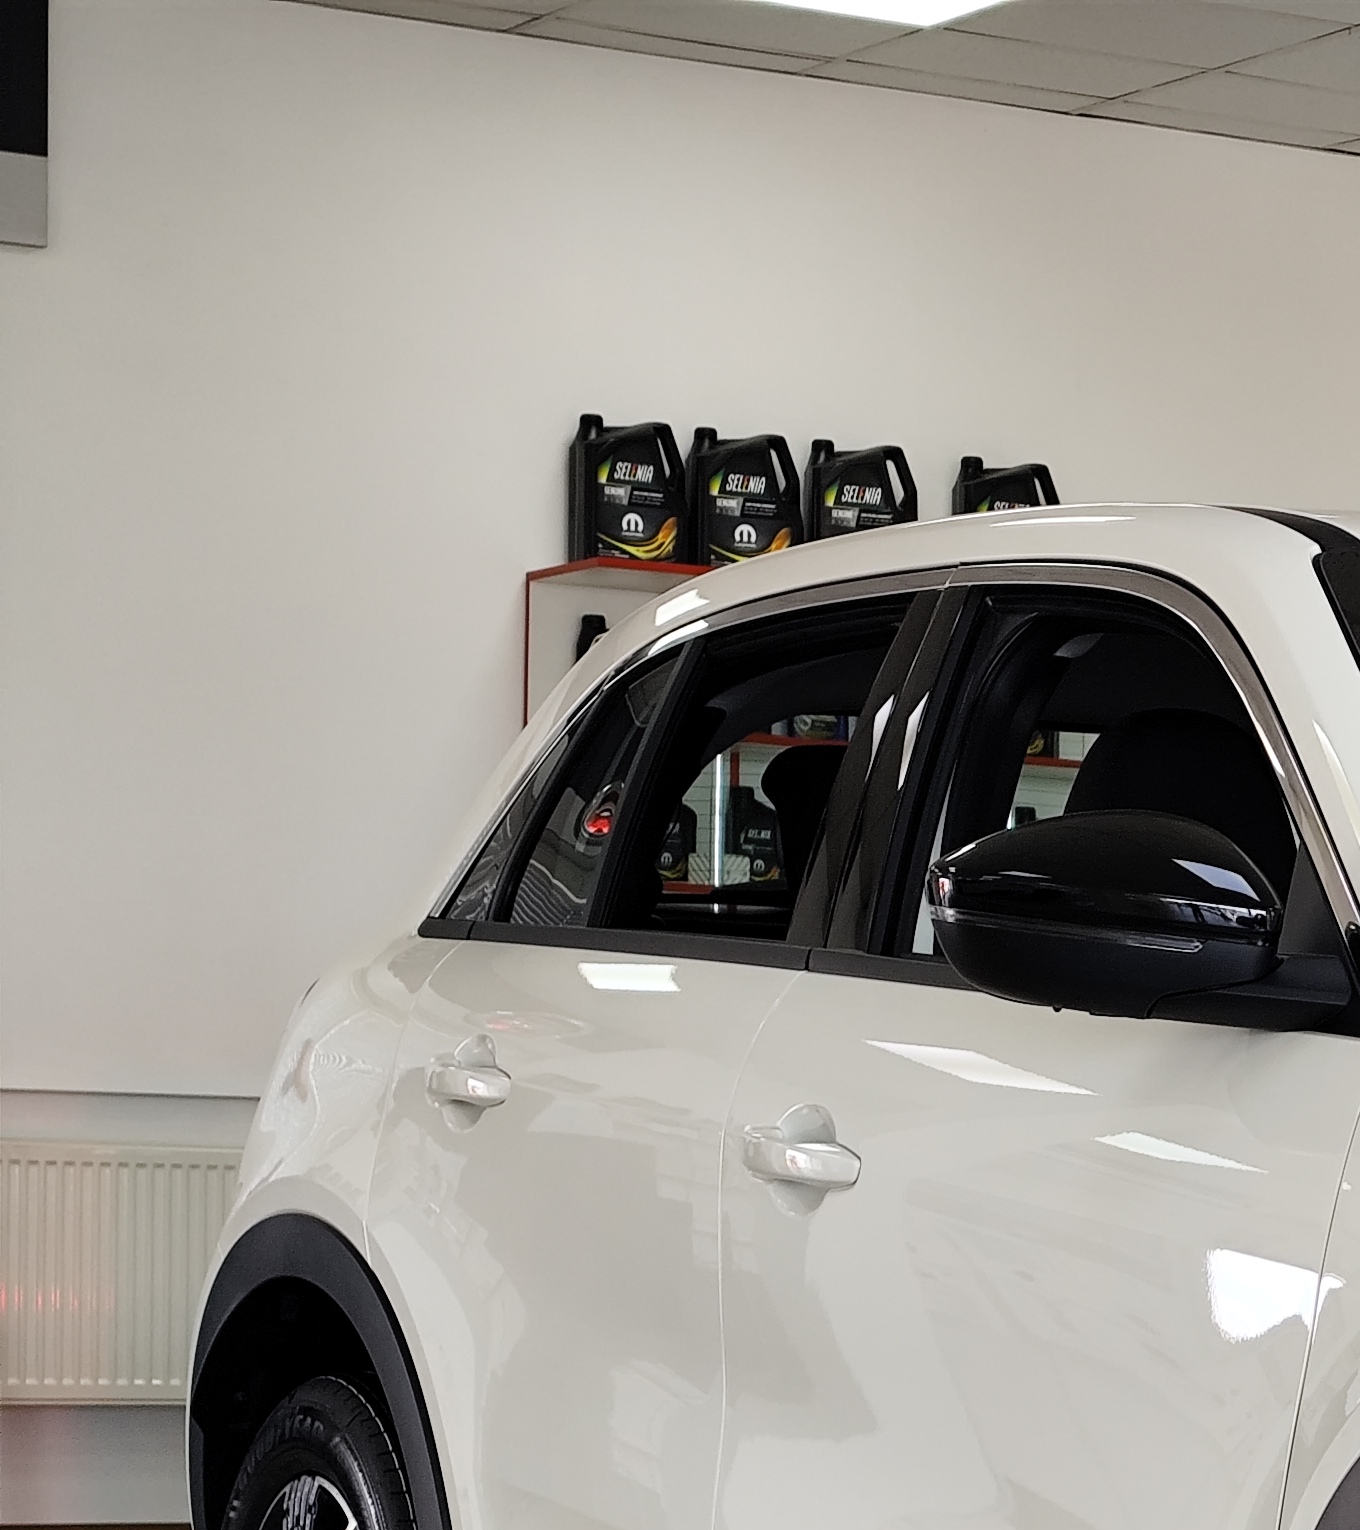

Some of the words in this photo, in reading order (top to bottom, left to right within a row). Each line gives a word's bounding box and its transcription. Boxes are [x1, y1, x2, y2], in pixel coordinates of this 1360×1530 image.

[613, 461, 654, 483] SELENIA
[726, 473, 766, 494] SELENIA
[841, 484, 882, 505] SELENIA
